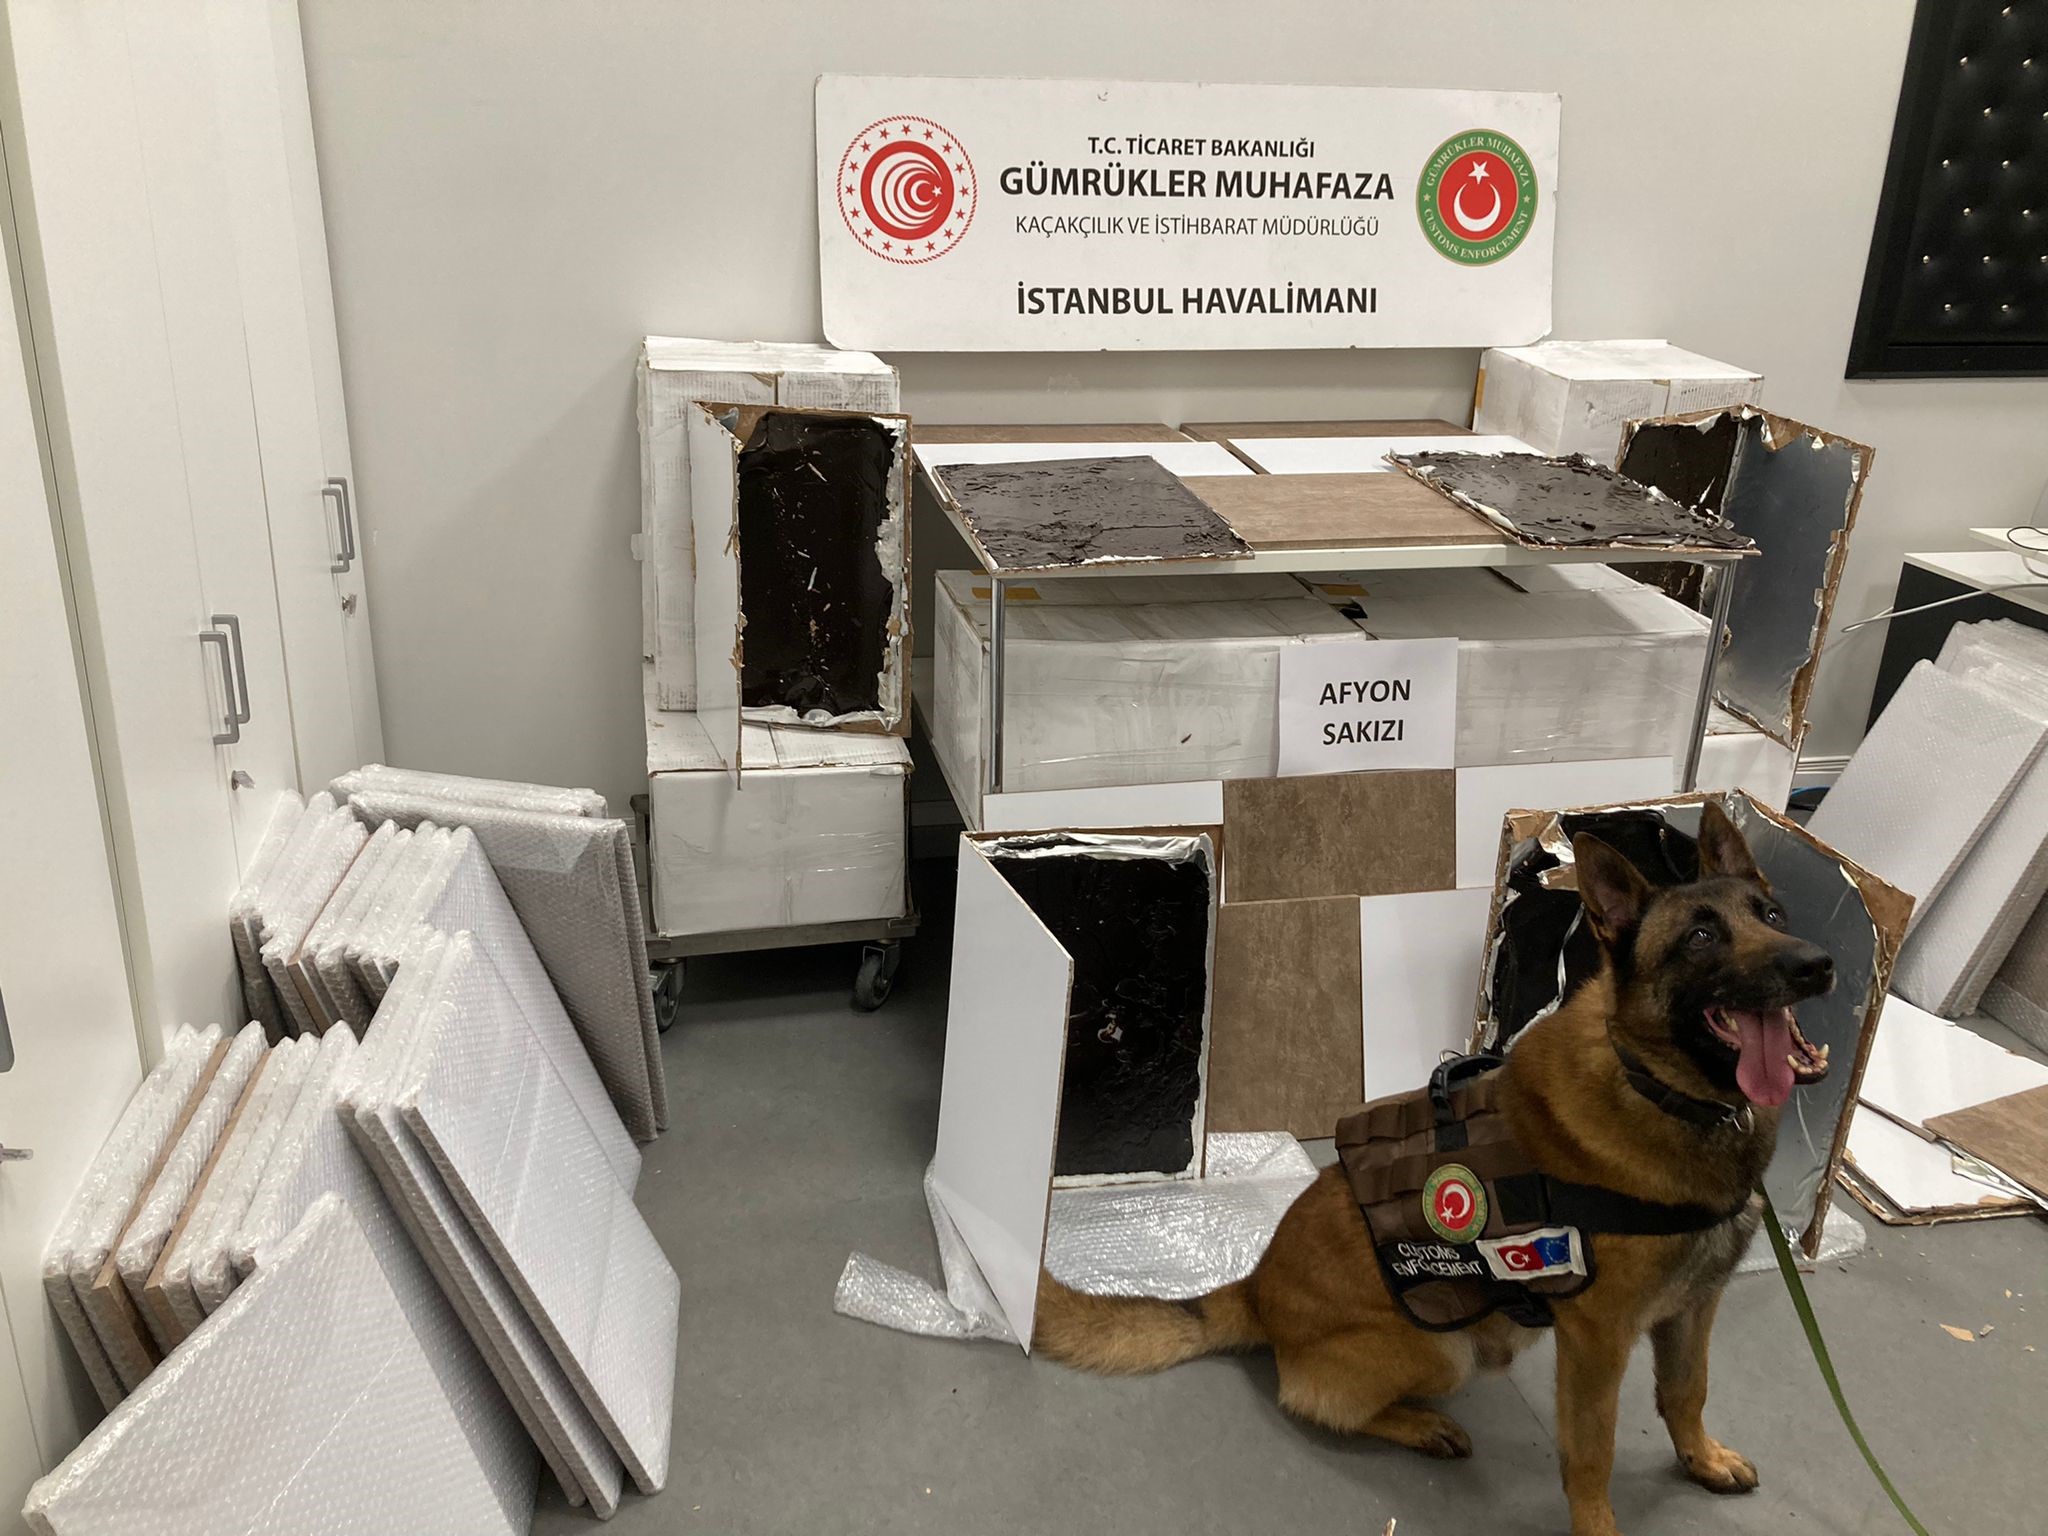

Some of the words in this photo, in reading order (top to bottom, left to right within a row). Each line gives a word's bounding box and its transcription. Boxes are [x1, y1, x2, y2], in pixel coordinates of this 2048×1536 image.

[1088, 136, 1122, 156] T.C.
[1126, 134, 1206, 157] TİCARET
[1212, 136, 1315, 159] BAKANLIĞI
[1424, 136, 1484, 187] GÜMRÜKLER
[1487, 137, 1530, 188] MUHAFAZA
[1000, 161, 1206, 199] GÜMRÜKLER
[1216, 168, 1395, 201] MUHAFAZA
[1016, 216, 1124, 238] KAÇAKÇILIK
[1128, 217, 1150, 236] VE
[1155, 212, 1258, 236] İSTİHBARAT
[1262, 210, 1379, 237] MÜDÜRLÜĞÜ
[1424, 208, 1459, 255] CUSTOMS
[1460, 210, 1529, 260] ENFORCEMENT
[1017, 279, 1174, 316] İSTANBUL
[1182, 282, 1377, 315] HAVALİMANI
[1319, 678, 1411, 706] AFYON
[1322, 718, 1404, 746] SAKIZI
[1391, 1258, 1484, 1277] ENFOCEMENT
